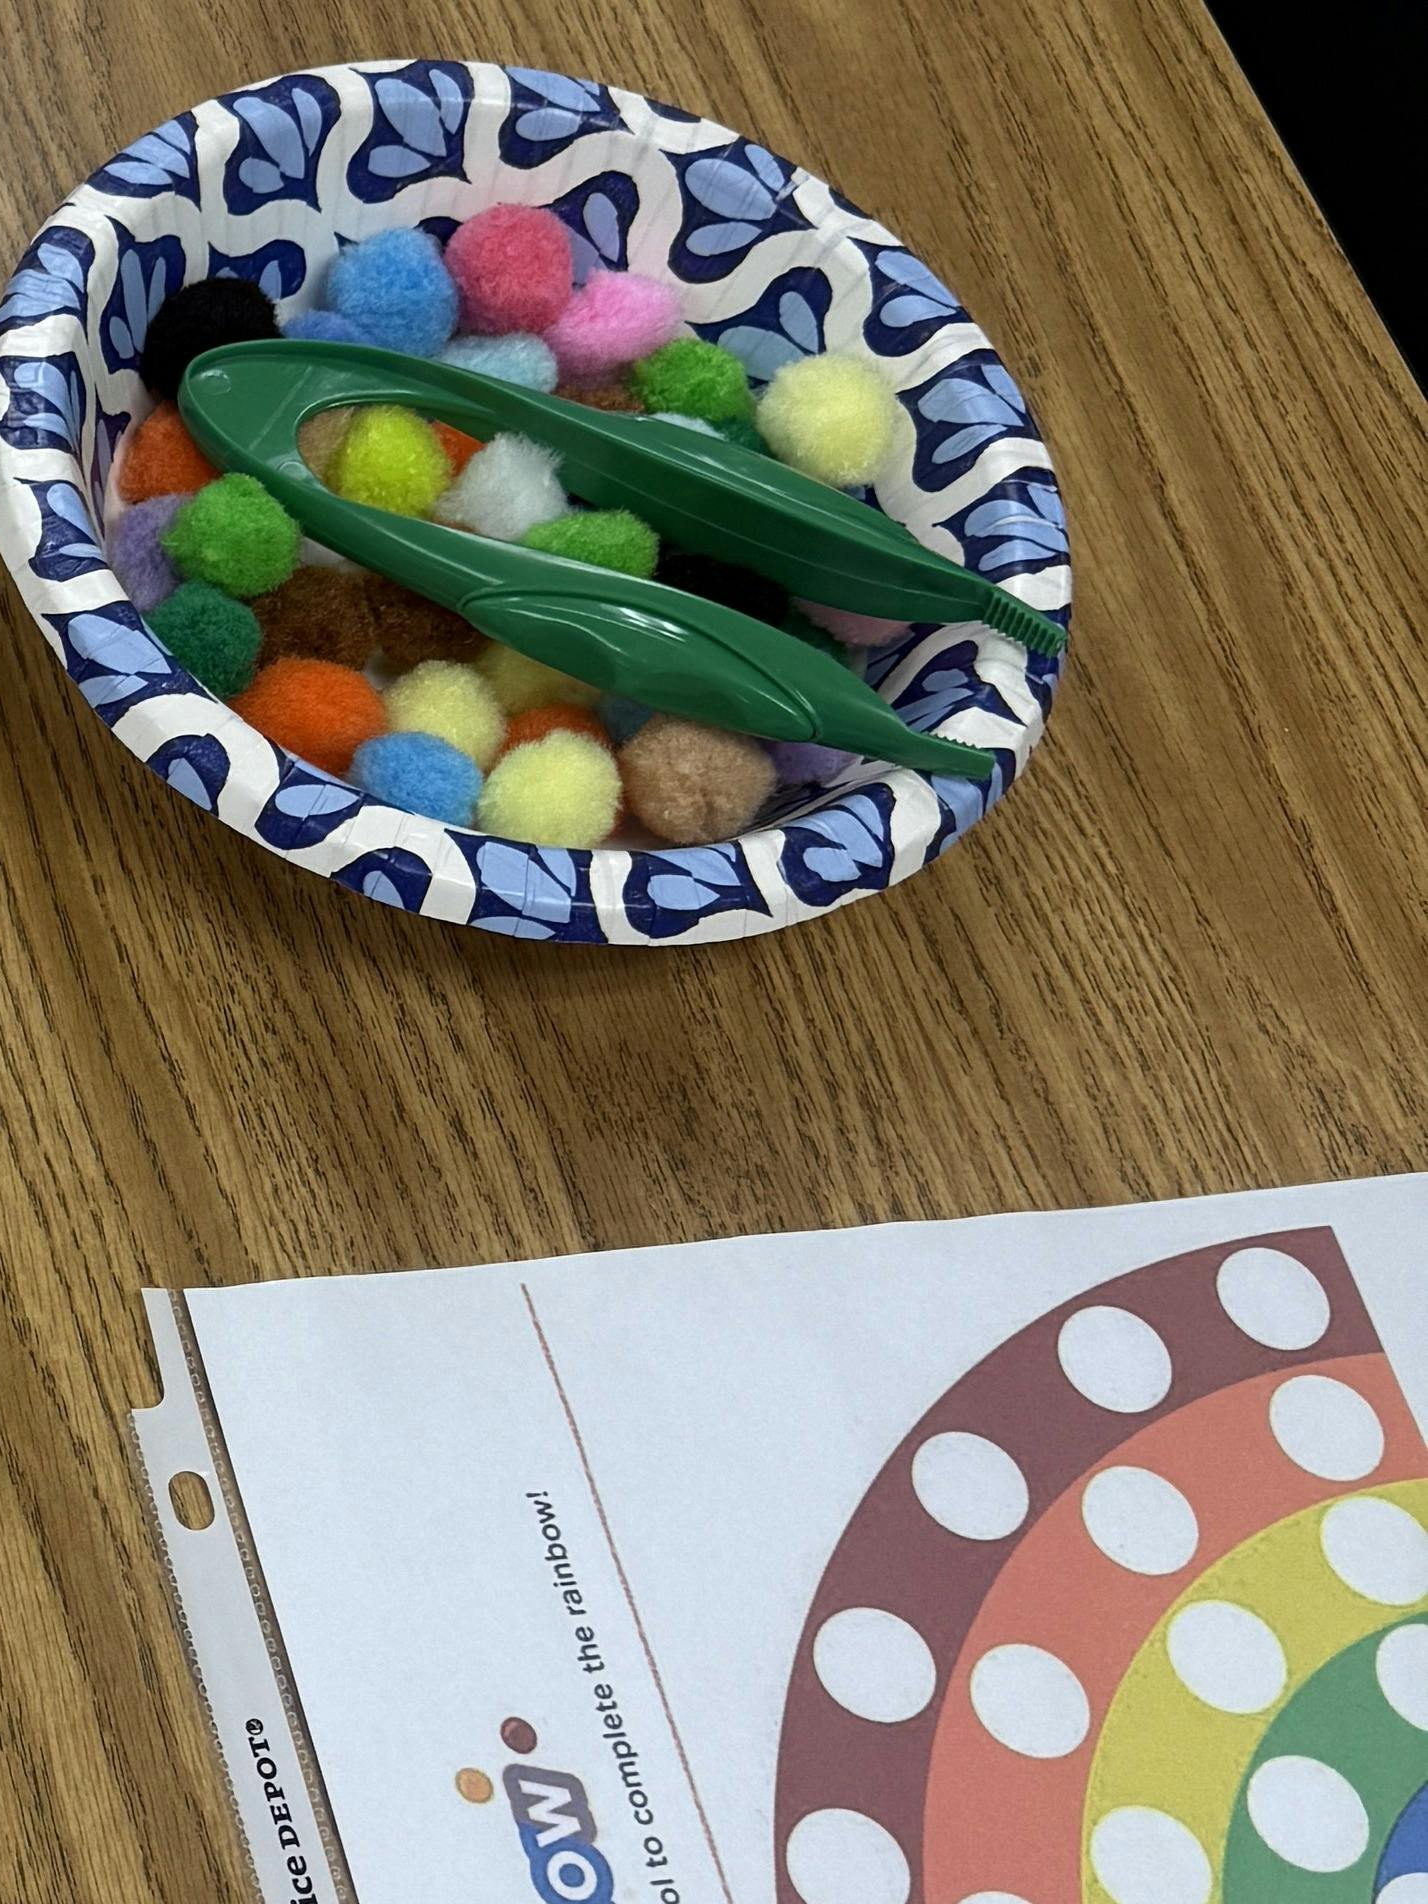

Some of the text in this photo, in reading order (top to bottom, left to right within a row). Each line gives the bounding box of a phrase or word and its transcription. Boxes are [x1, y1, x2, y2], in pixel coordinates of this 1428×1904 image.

[526, 1491, 587, 1615] rainbow!
[575, 1626, 605, 1674] the
[594, 1684, 654, 1825] complete
[643, 1836, 668, 1868] to
